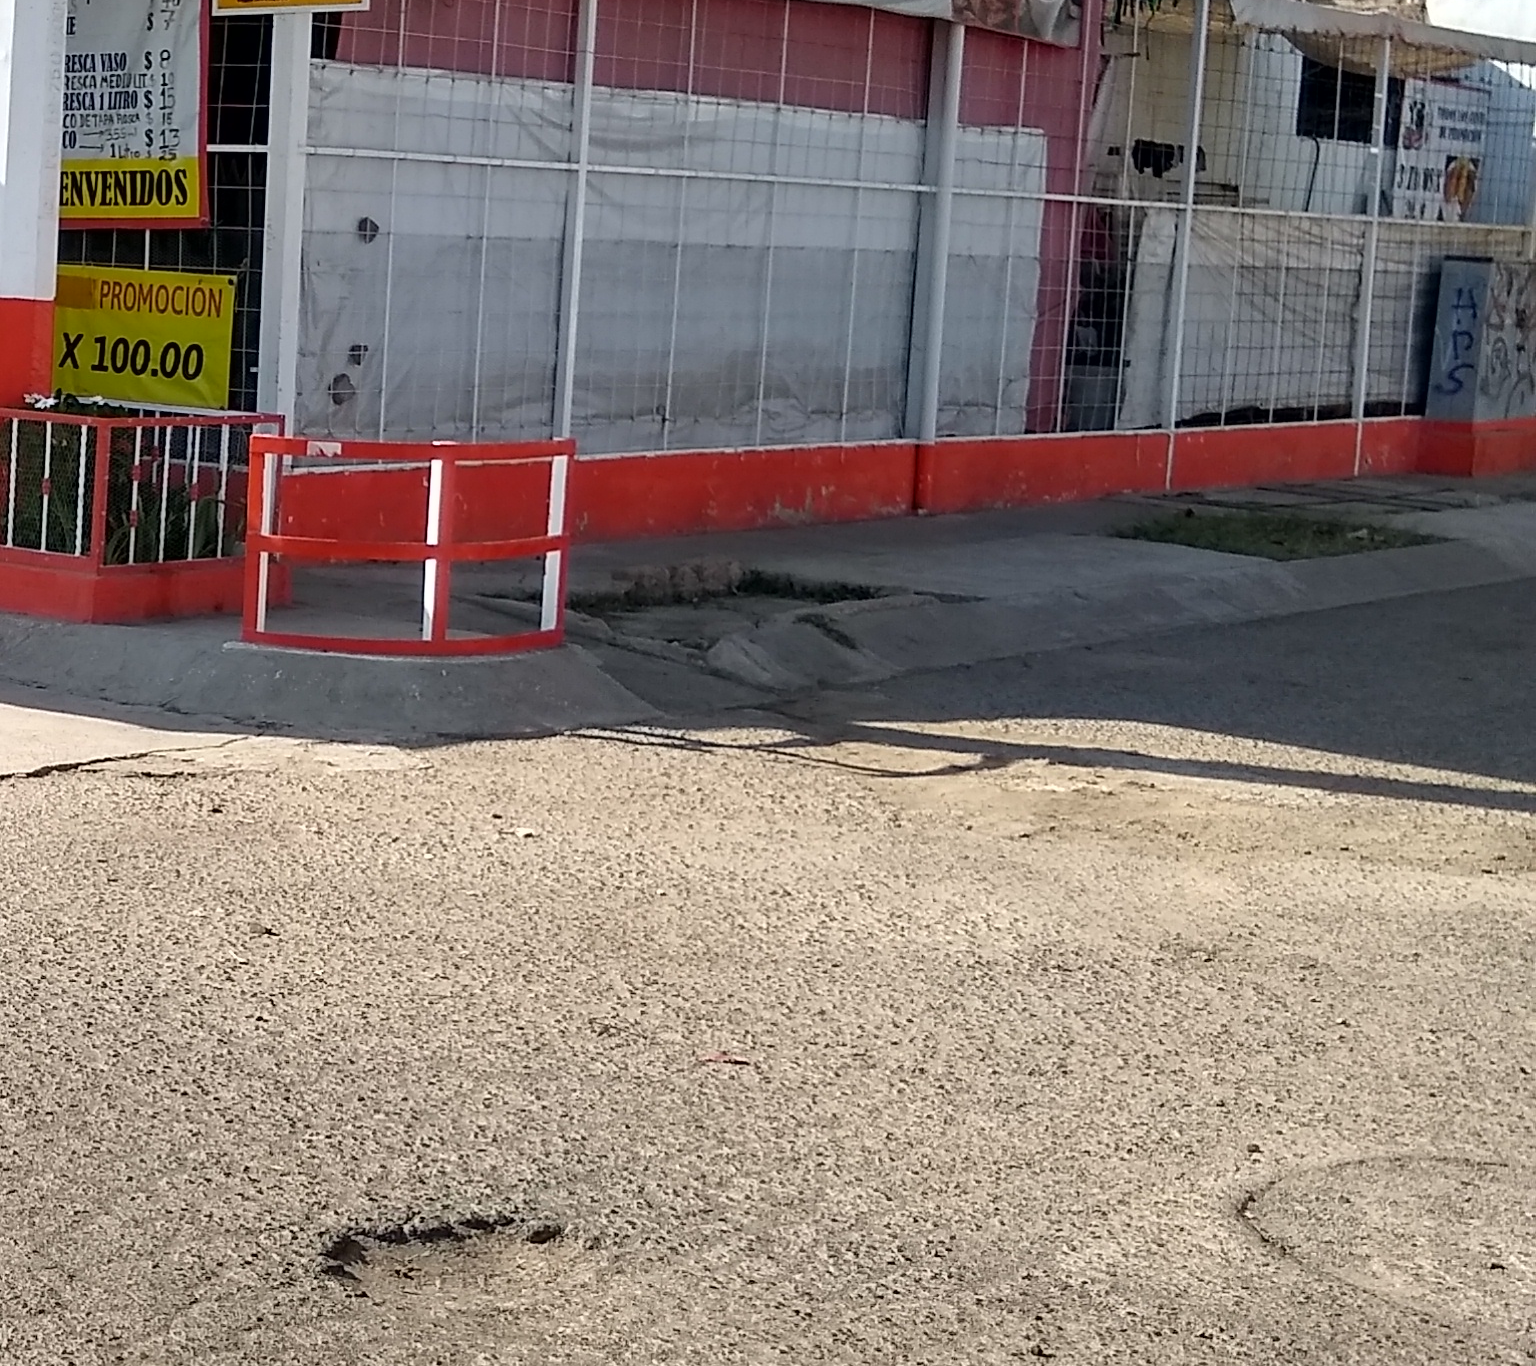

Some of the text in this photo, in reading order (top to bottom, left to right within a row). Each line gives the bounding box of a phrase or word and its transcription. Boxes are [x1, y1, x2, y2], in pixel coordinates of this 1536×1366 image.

[64, 53, 96, 73] RESCA
[100, 52, 127, 72] VASO
[64, 74, 96, 91] RESCA
[63, 92, 95, 111] RESCA
[99, 92, 104, 111] 1
[107, 90, 138, 110] LITRO
[63, 113, 77, 129] CO
[62, 131, 77, 149] CO
[60, 168, 188, 207] ENVENIDOS
[99, 279, 223, 318] PROMOCIÓN
[58, 332, 204, 381] X 100.00
